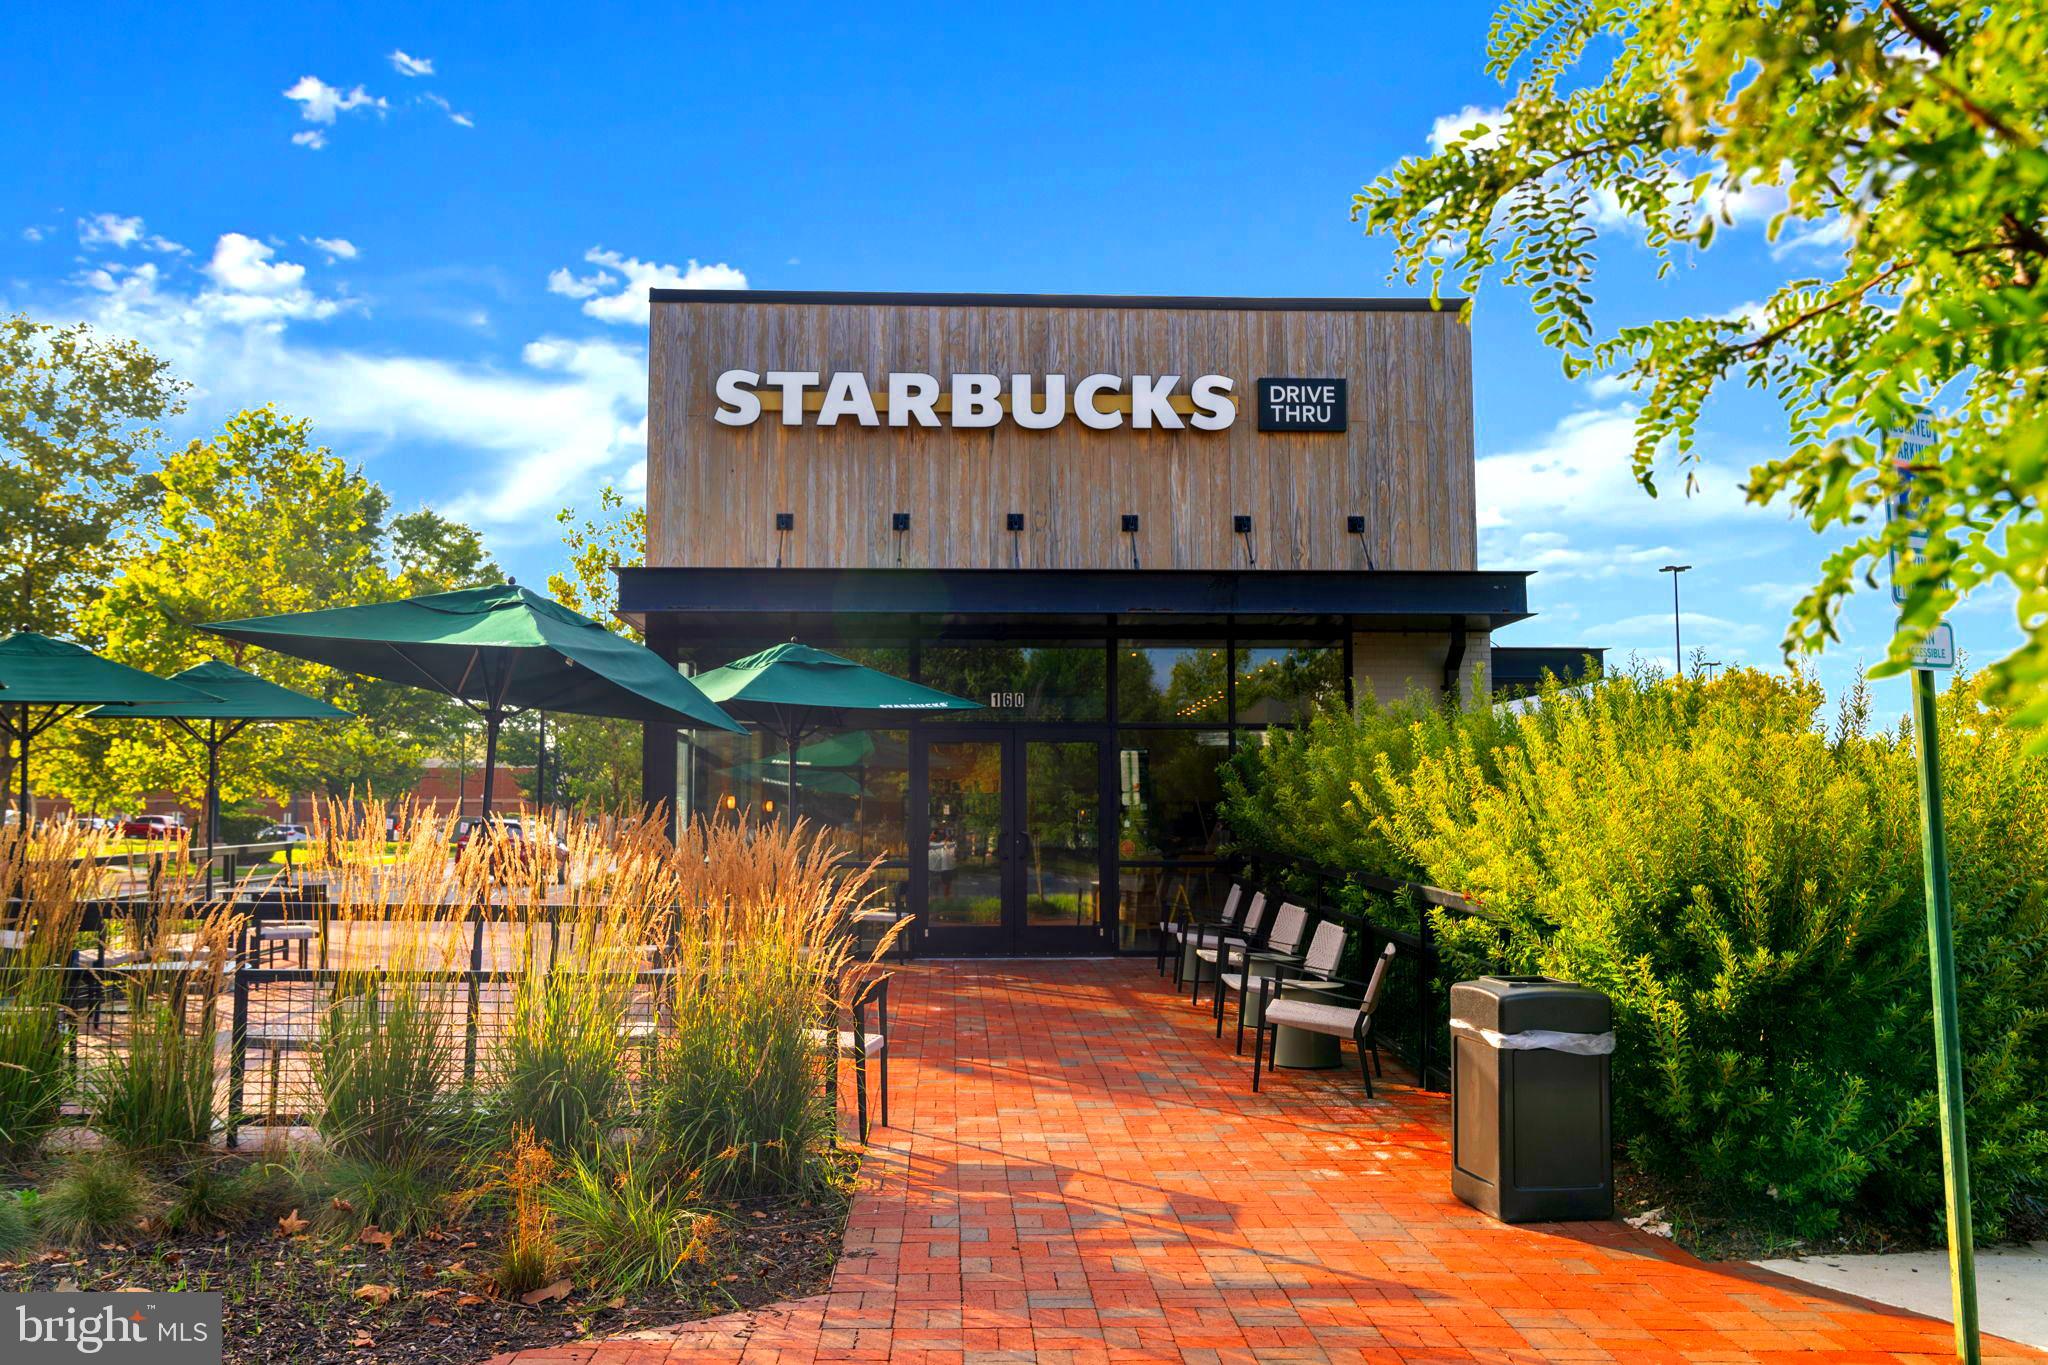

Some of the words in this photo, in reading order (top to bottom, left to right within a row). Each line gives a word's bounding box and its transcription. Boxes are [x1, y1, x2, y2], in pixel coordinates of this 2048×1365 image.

[714, 369, 1236, 431] STARBUCKS
[1269, 385, 1336, 403] DRIVE
[1270, 405, 1332, 423] THRU
[1896, 441, 1930, 461] ARKIN
[991, 693, 1024, 708] 160
